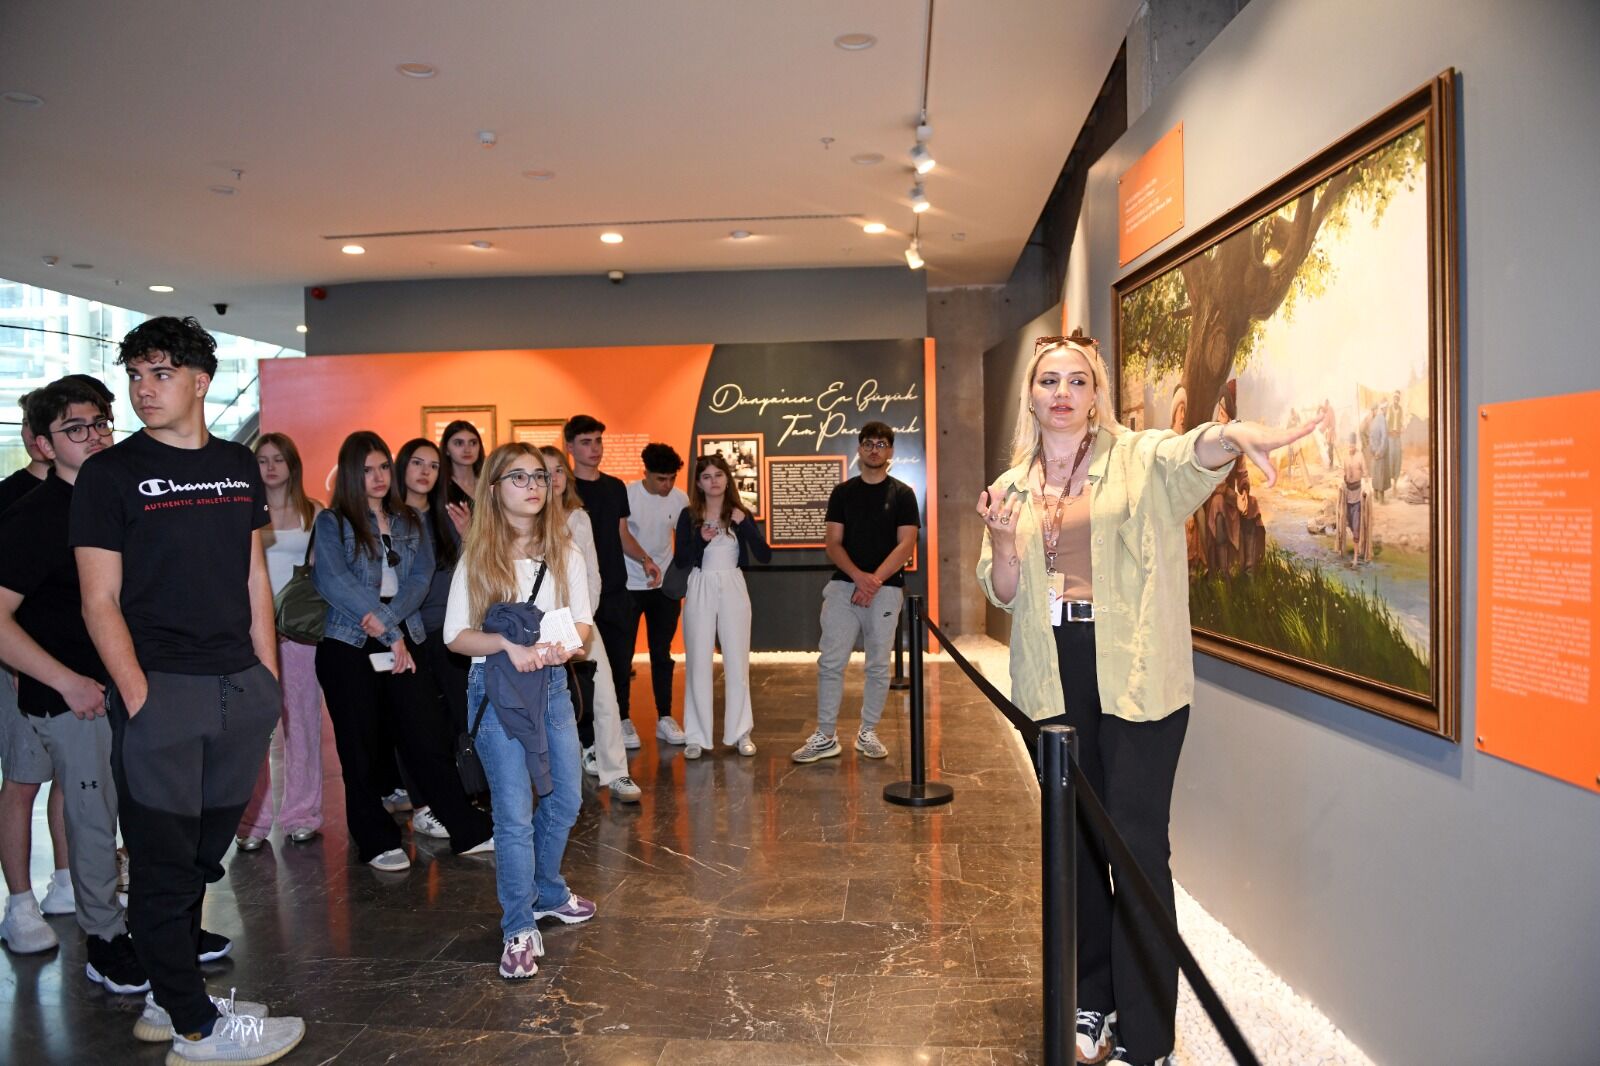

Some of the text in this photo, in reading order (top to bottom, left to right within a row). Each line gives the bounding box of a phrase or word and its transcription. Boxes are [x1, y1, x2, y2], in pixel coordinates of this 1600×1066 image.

[817, 381, 853, 411] En
[856, 379, 918, 413] Büyük
[777, 411, 920, 452] Tam Panmik
[138, 478, 250, 497] Champion
[144, 499, 193, 511] AUTHENTIC
[196, 496, 231, 505] ATHLETIC
